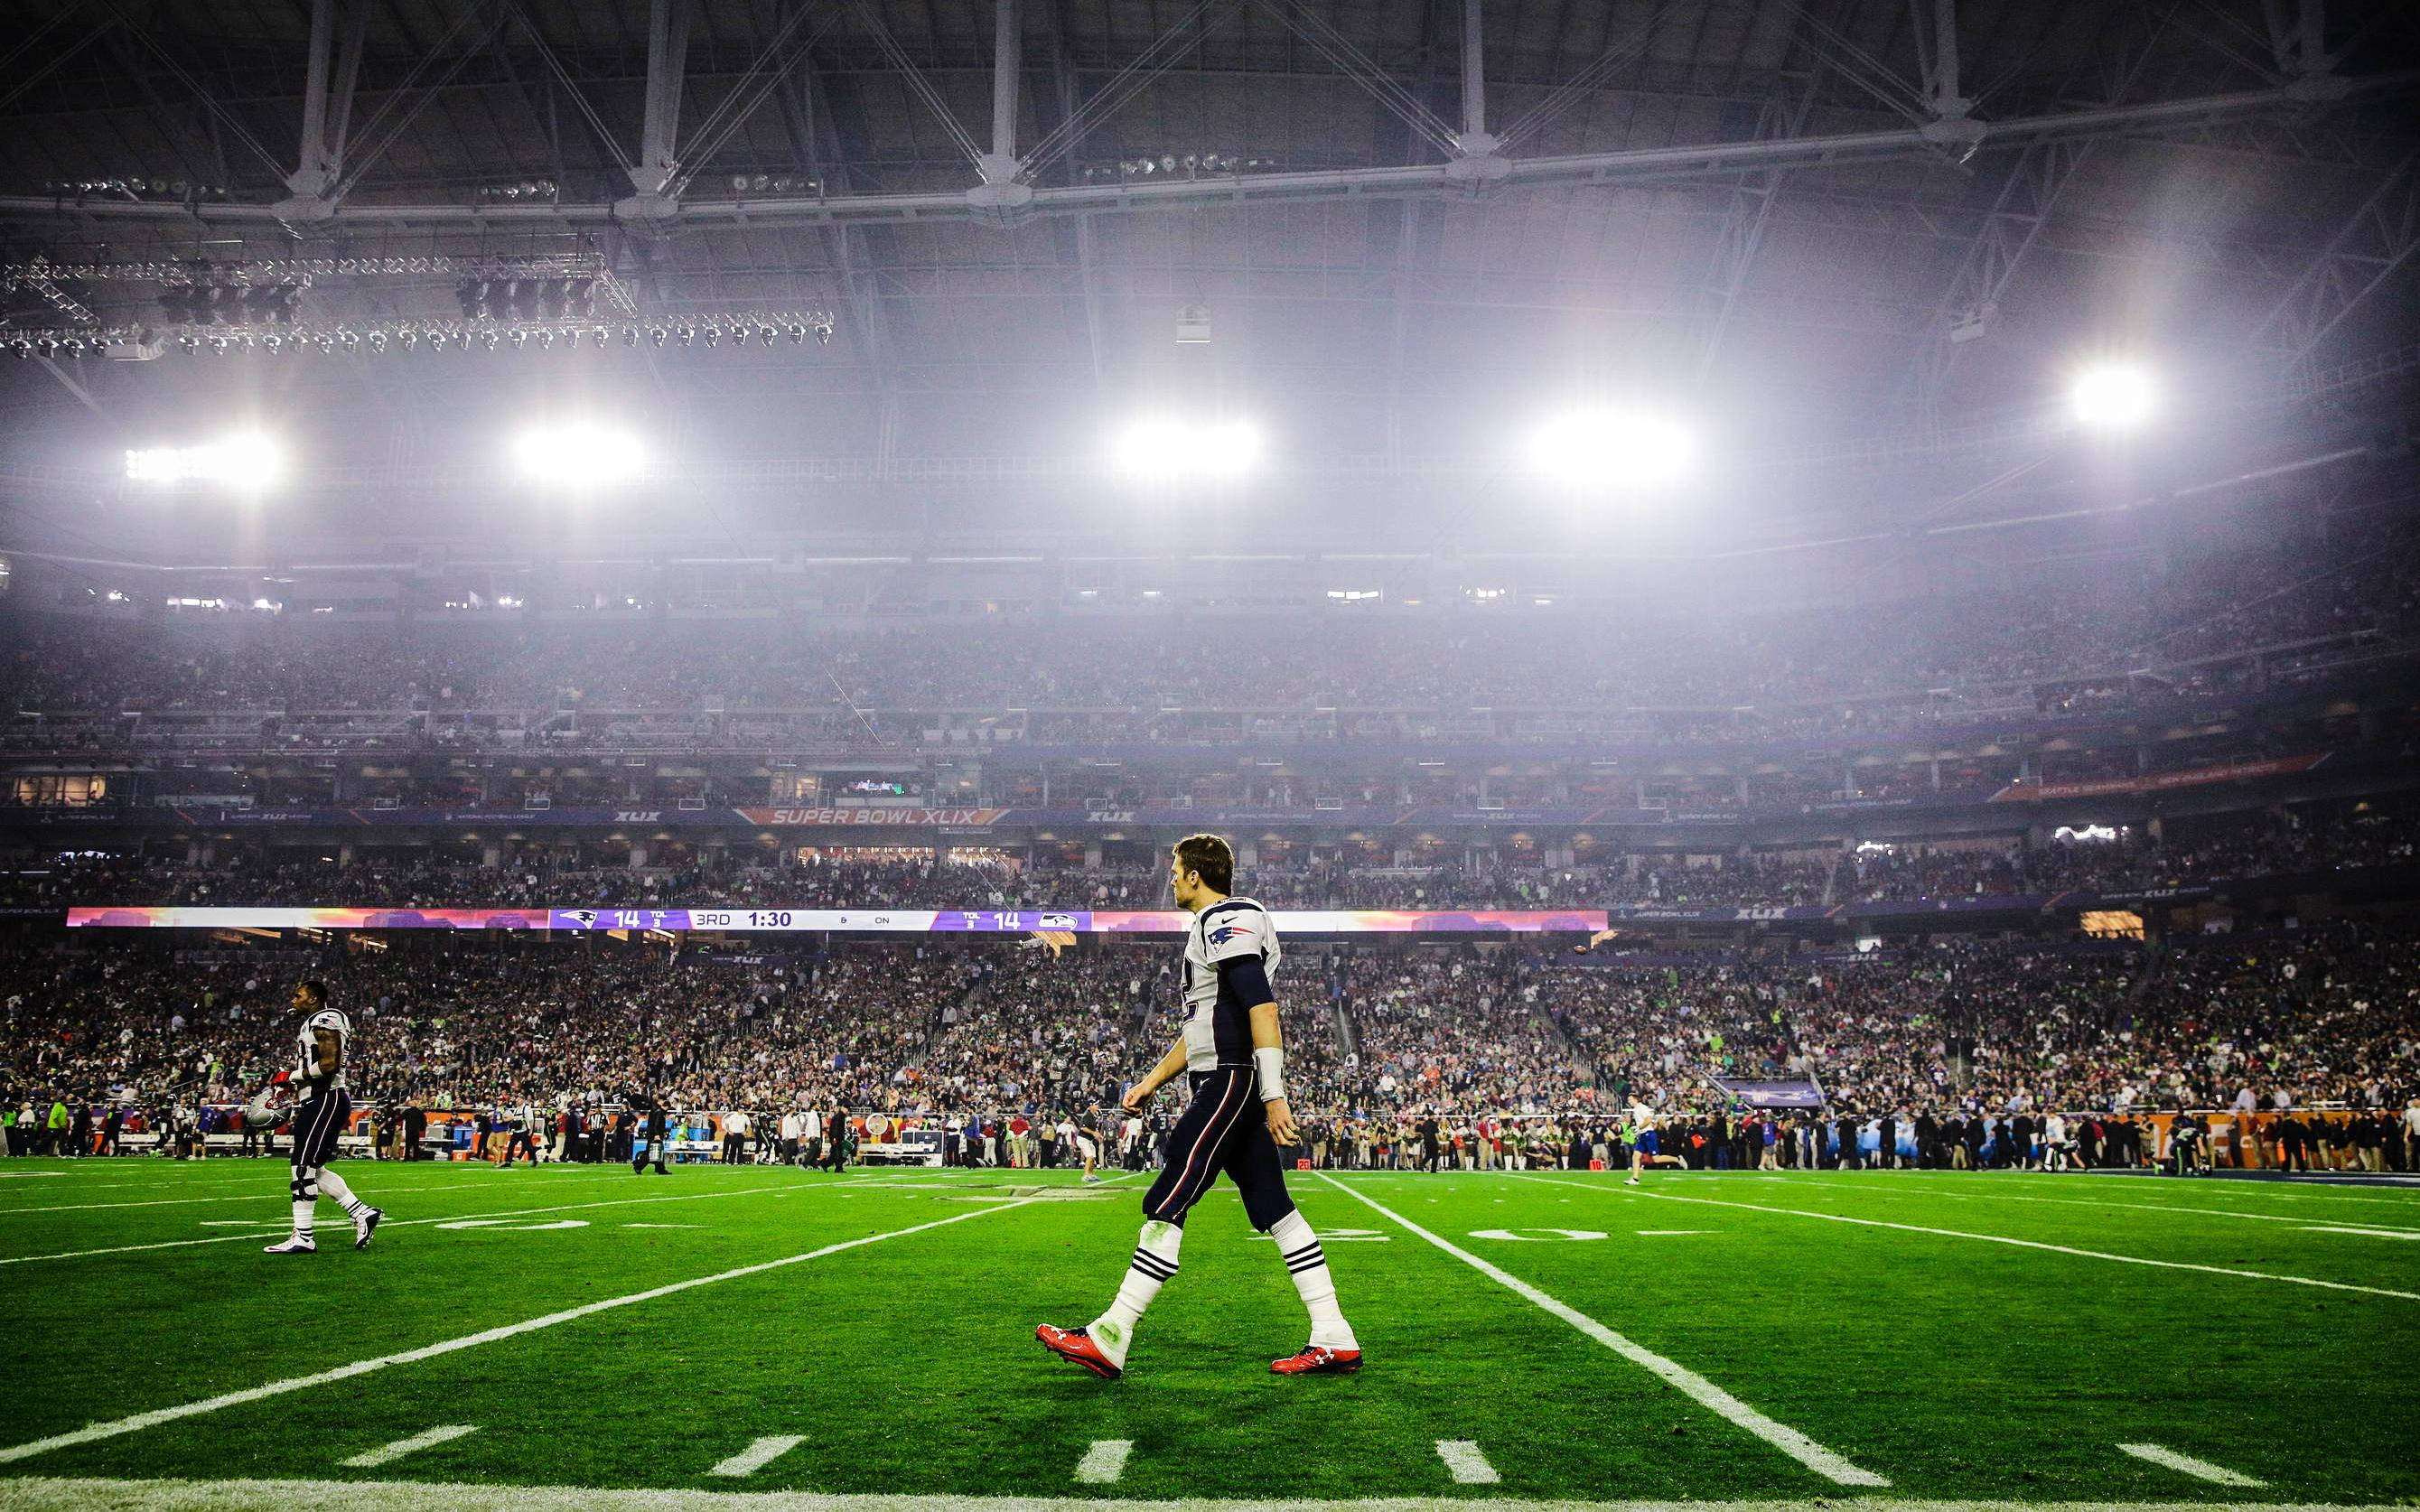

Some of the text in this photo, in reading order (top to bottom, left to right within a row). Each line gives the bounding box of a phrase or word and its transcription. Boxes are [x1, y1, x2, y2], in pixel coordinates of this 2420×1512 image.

[614, 811, 661, 822] XLIX
[771, 809, 977, 824] SUPER BOWL XLIX
[1087, 812, 1135, 822] XLIX
[614, 910, 640, 928] 14
[649, 910, 668, 919] TOL
[696, 911, 792, 927] 3RD 1:30
[963, 911, 981, 919] TOL
[653, 918, 661, 928] 3
[874, 916, 890, 925] ON
[967, 919, 975, 929] 3
[994, 911, 1021, 929] 14
